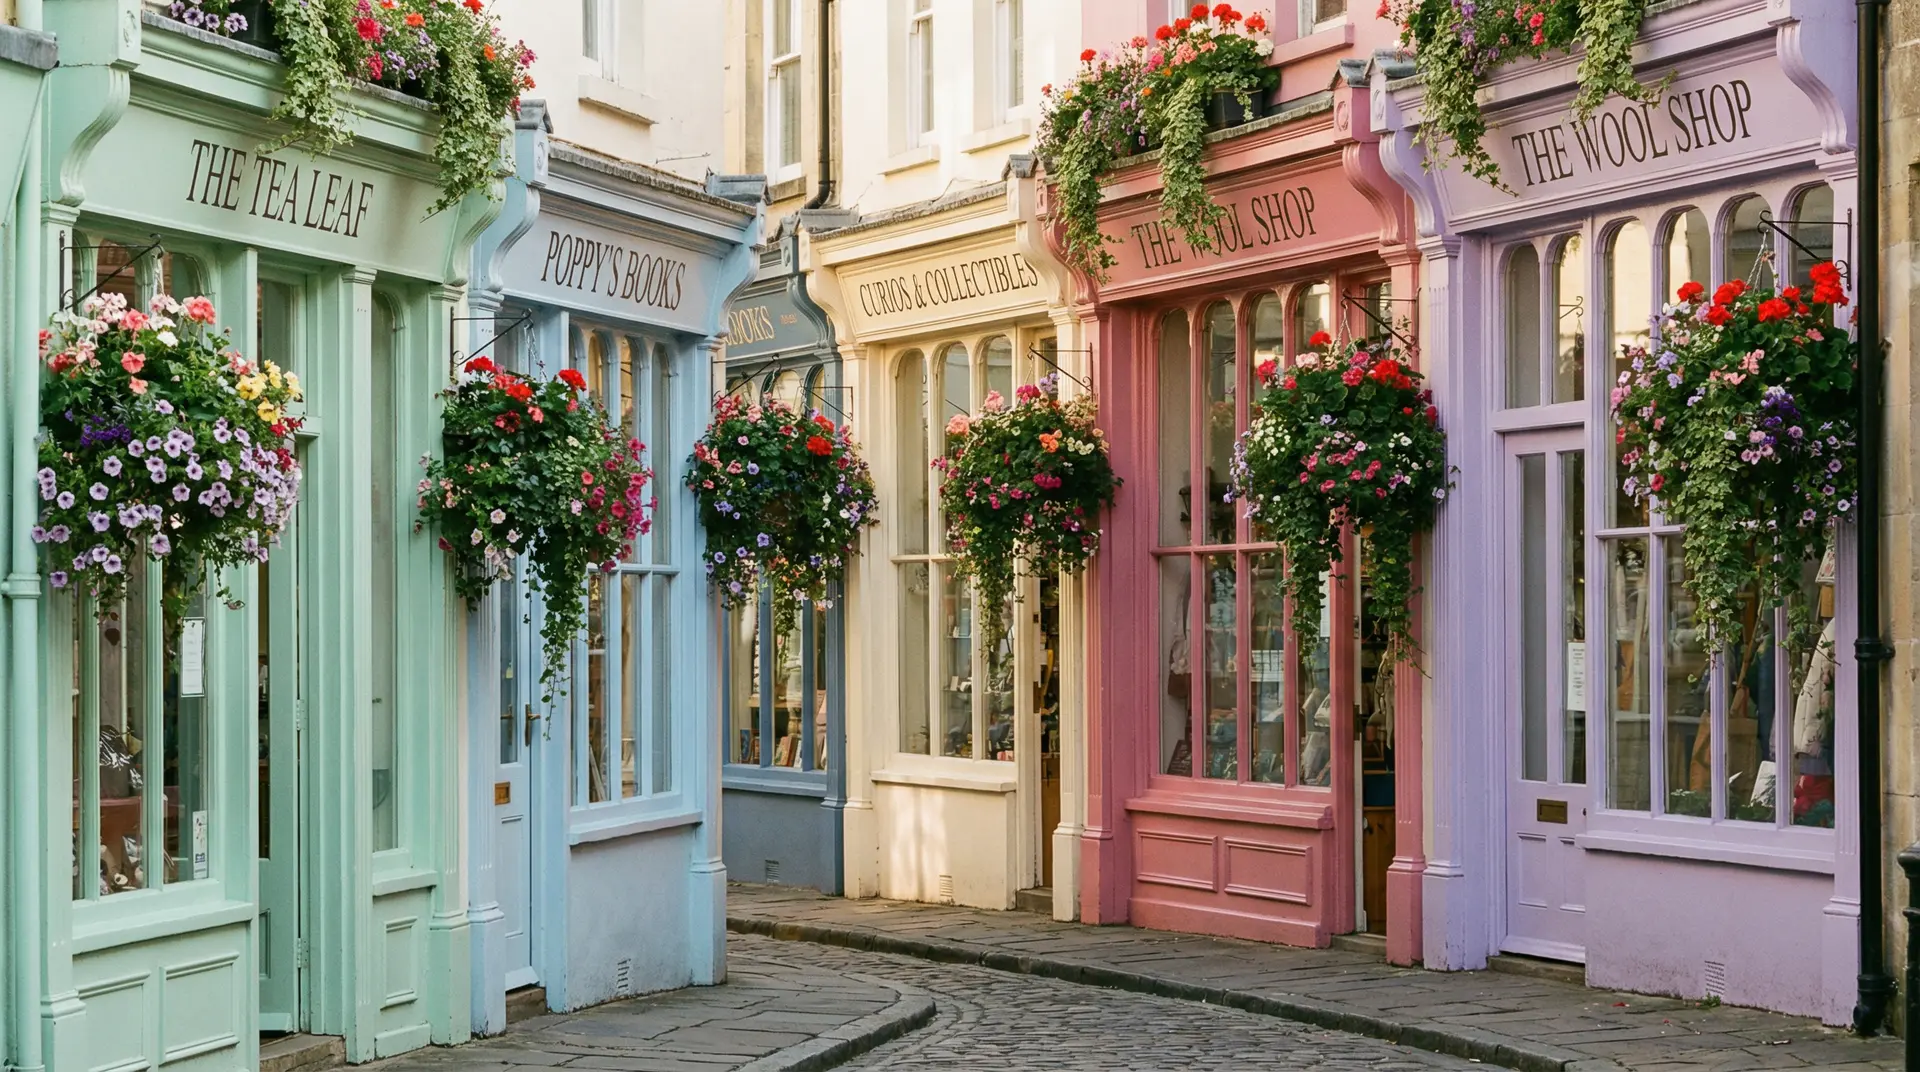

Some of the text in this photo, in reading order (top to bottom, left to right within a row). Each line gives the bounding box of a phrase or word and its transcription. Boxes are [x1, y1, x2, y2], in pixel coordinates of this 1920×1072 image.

[1511, 79, 1752, 187] THE WOOL SHOP
[186, 139, 374, 238] THE TEA LEAF
[1131, 221, 1182, 269] THE
[1252, 186, 1317, 246] SHOP
[541, 230, 686, 311] POPPY'S BOOKS
[859, 253, 1038, 317] CURIOS & COLLECTIBLES
